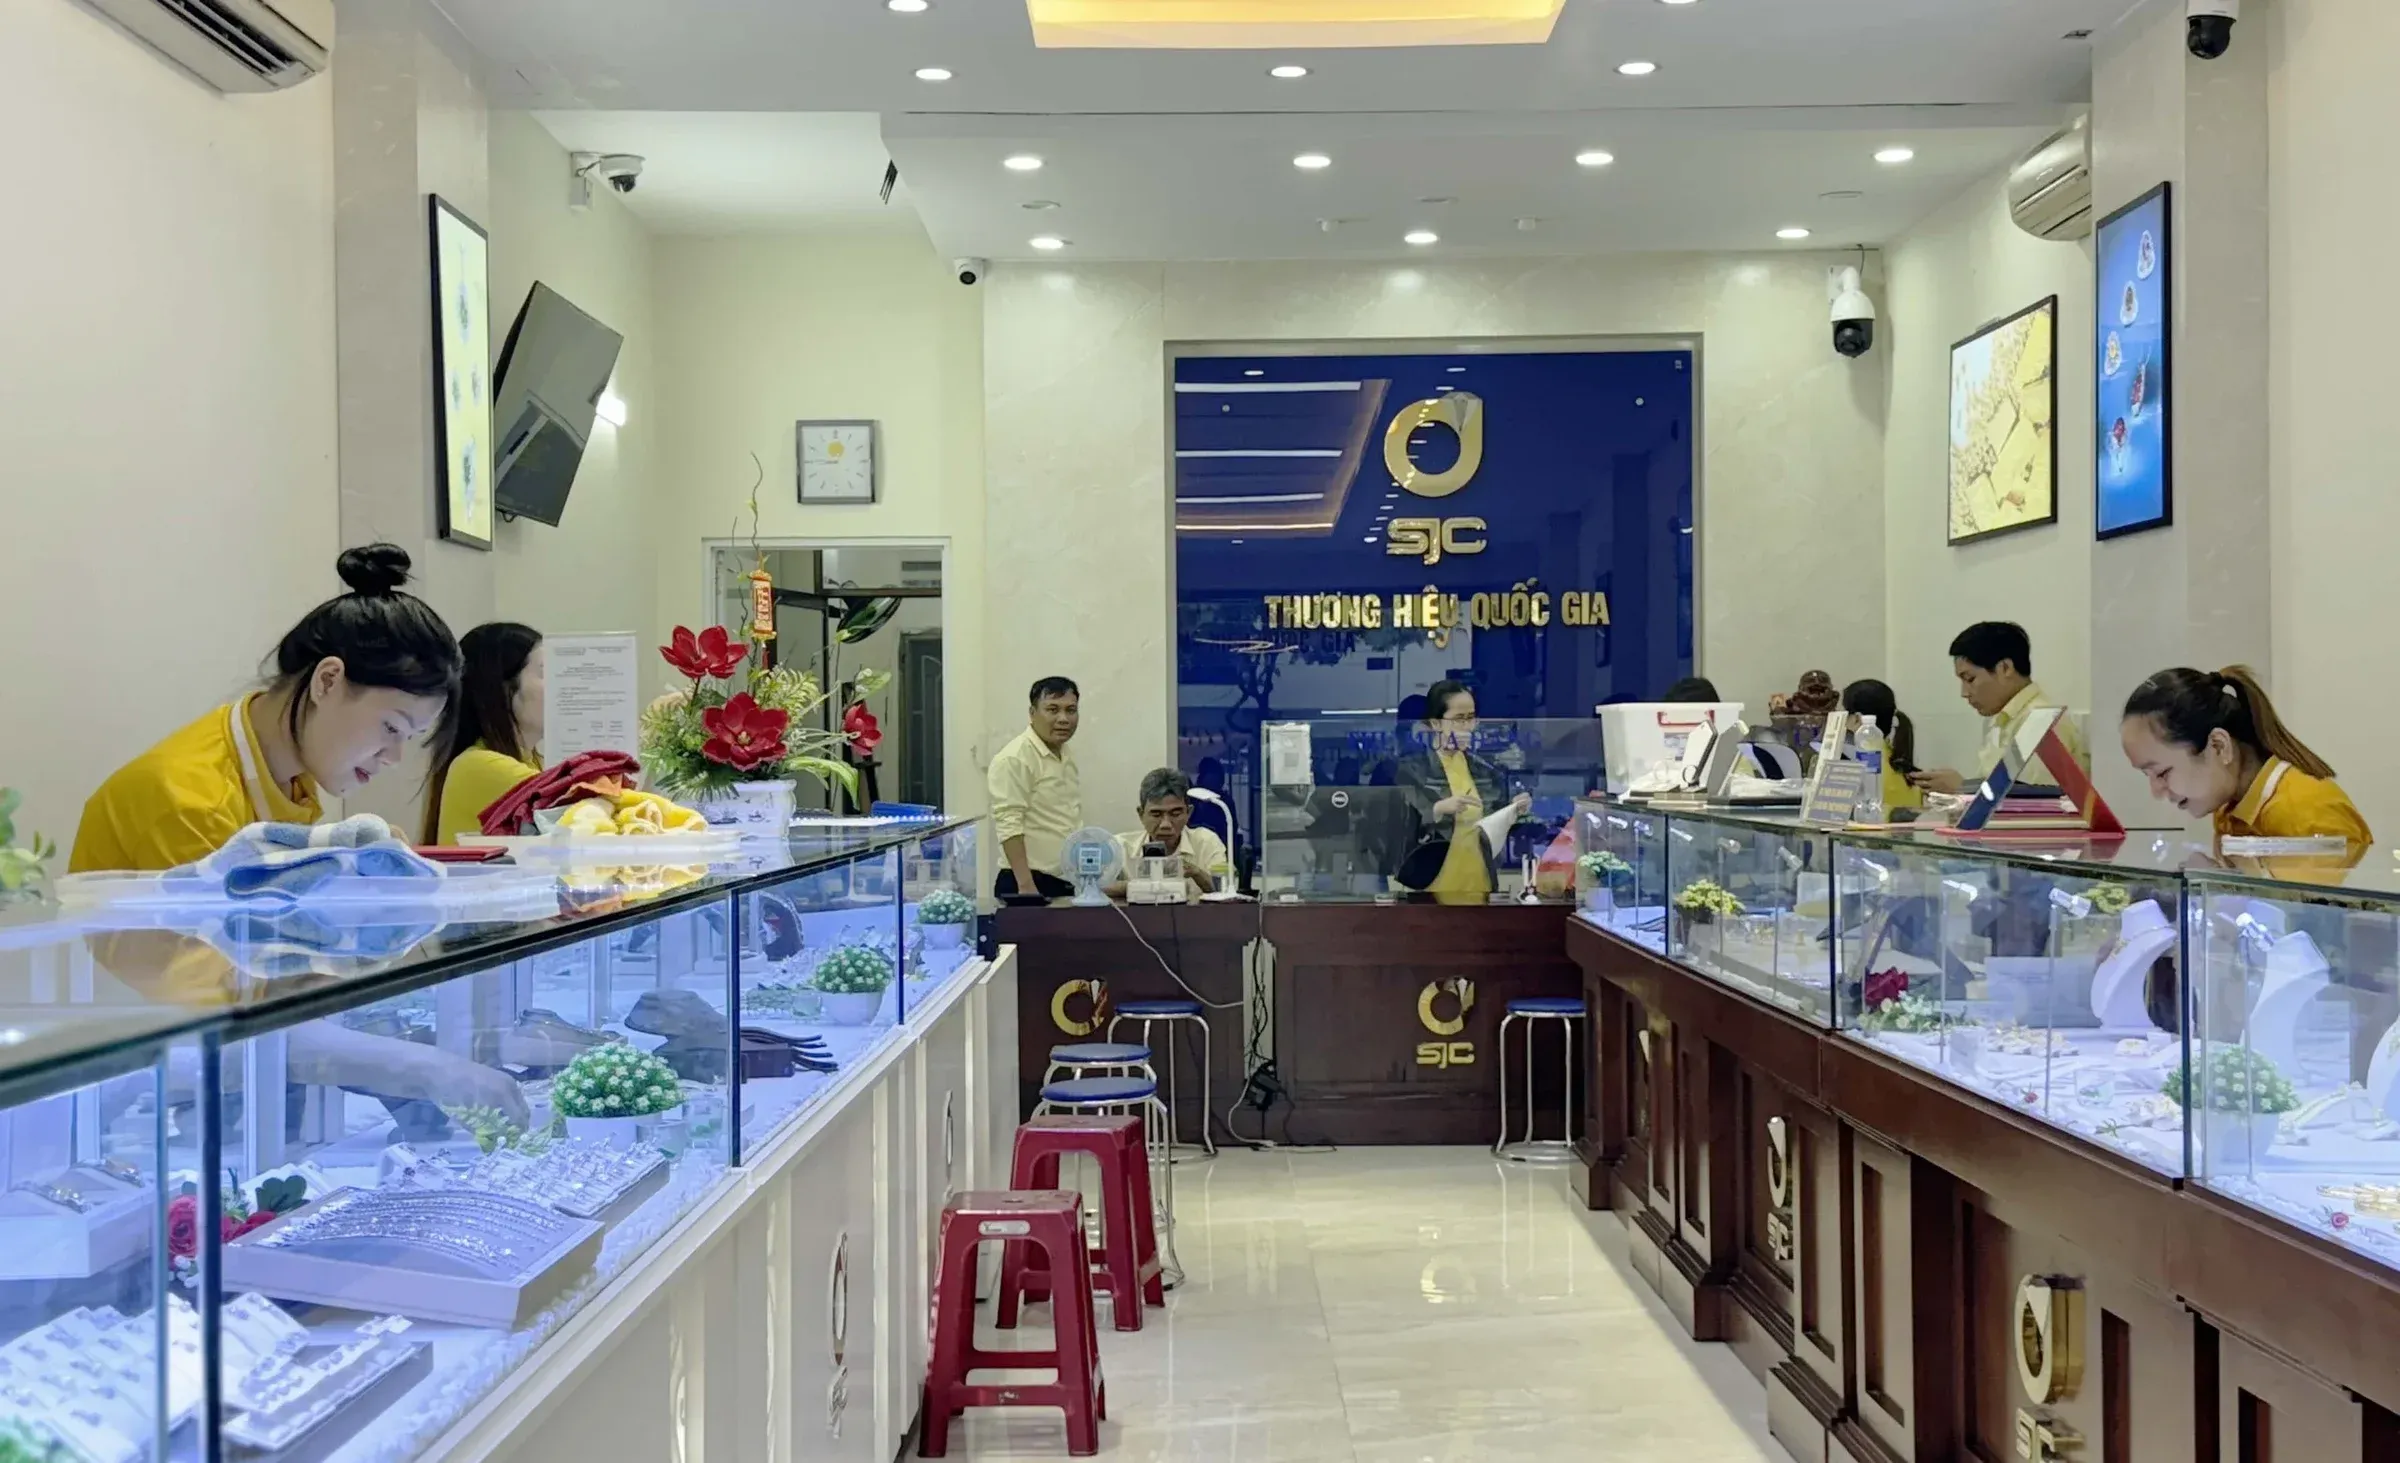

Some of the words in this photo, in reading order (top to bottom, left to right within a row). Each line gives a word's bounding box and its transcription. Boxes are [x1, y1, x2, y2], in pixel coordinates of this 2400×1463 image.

[1386, 517, 1487, 565] SJC
[1264, 591, 1382, 629] THƯƠNG
[1393, 584, 1459, 638] HIỆU
[1471, 577, 1550, 631] QUỐC
[1561, 591, 1611, 626] GIA
[1416, 1042, 1475, 1069] SJC
